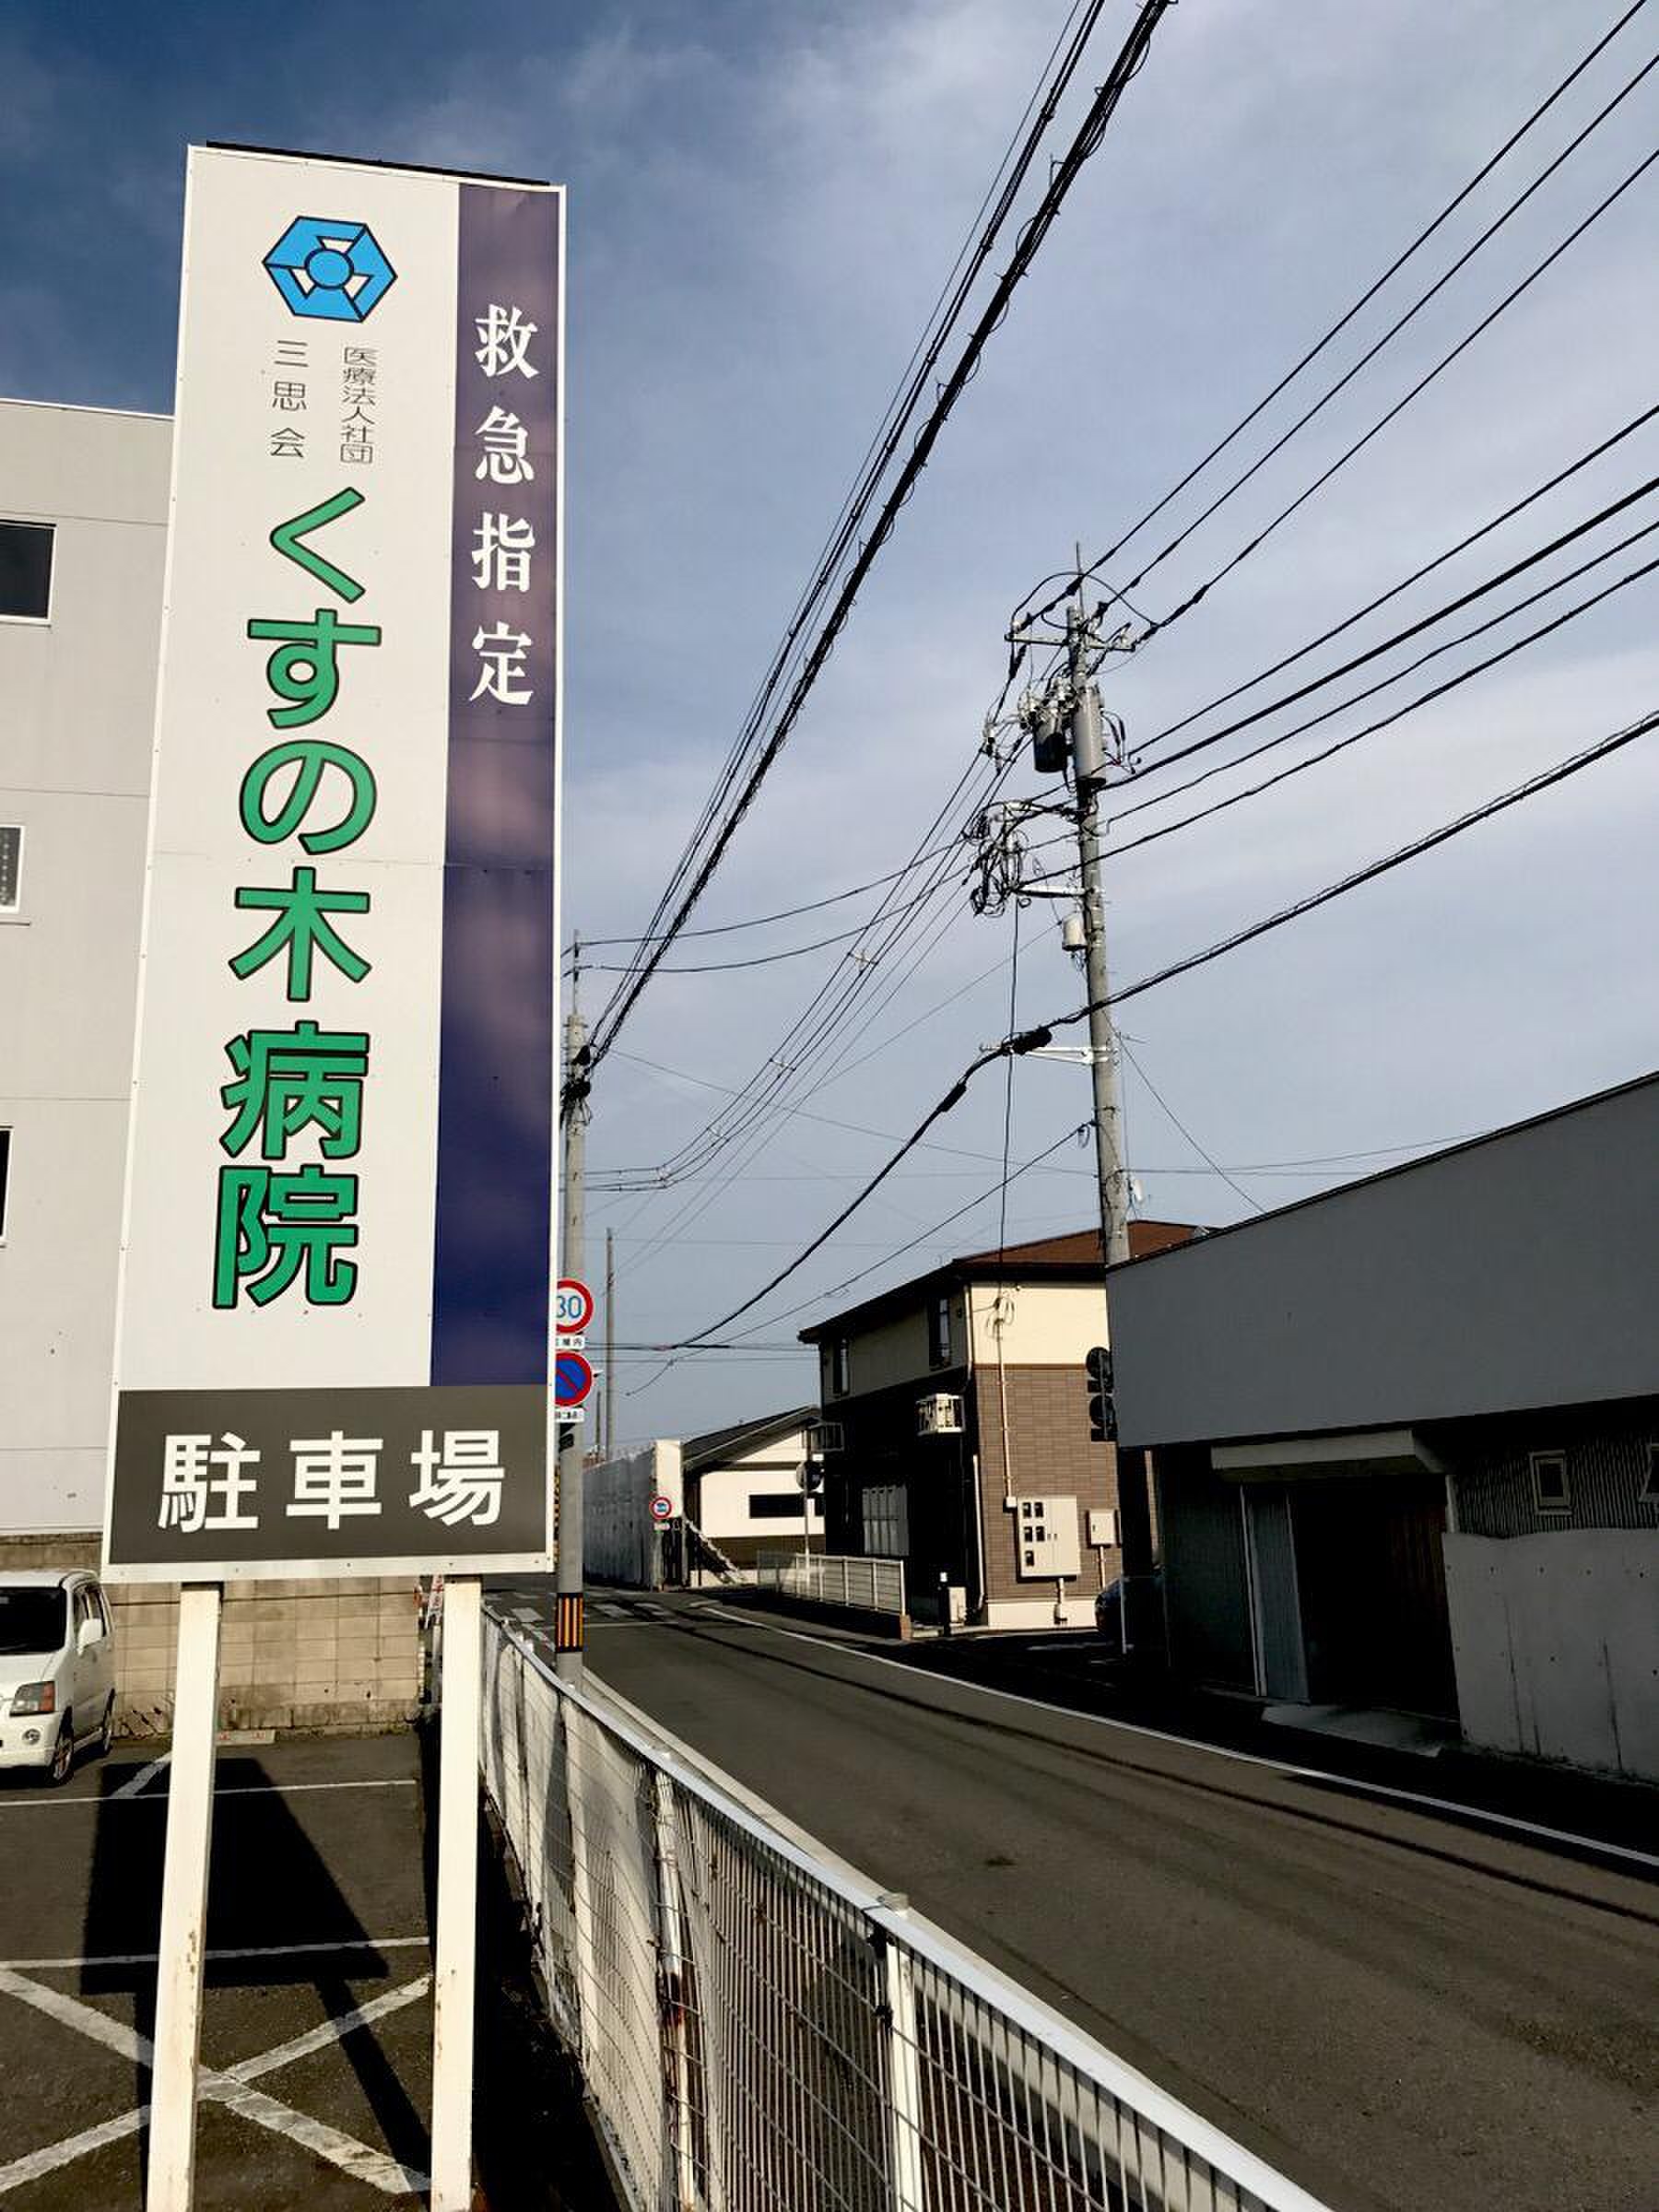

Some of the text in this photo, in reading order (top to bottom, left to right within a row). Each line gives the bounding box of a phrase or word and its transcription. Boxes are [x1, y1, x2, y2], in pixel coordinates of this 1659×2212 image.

[270, 340, 309, 459] 三思会
[340, 347, 376, 464] 医療法人社団
[469, 304, 539, 706] 救急指定
[211, 486, 382, 1310] くすの木病院
[158, 1430, 506, 1533] 駐車場
